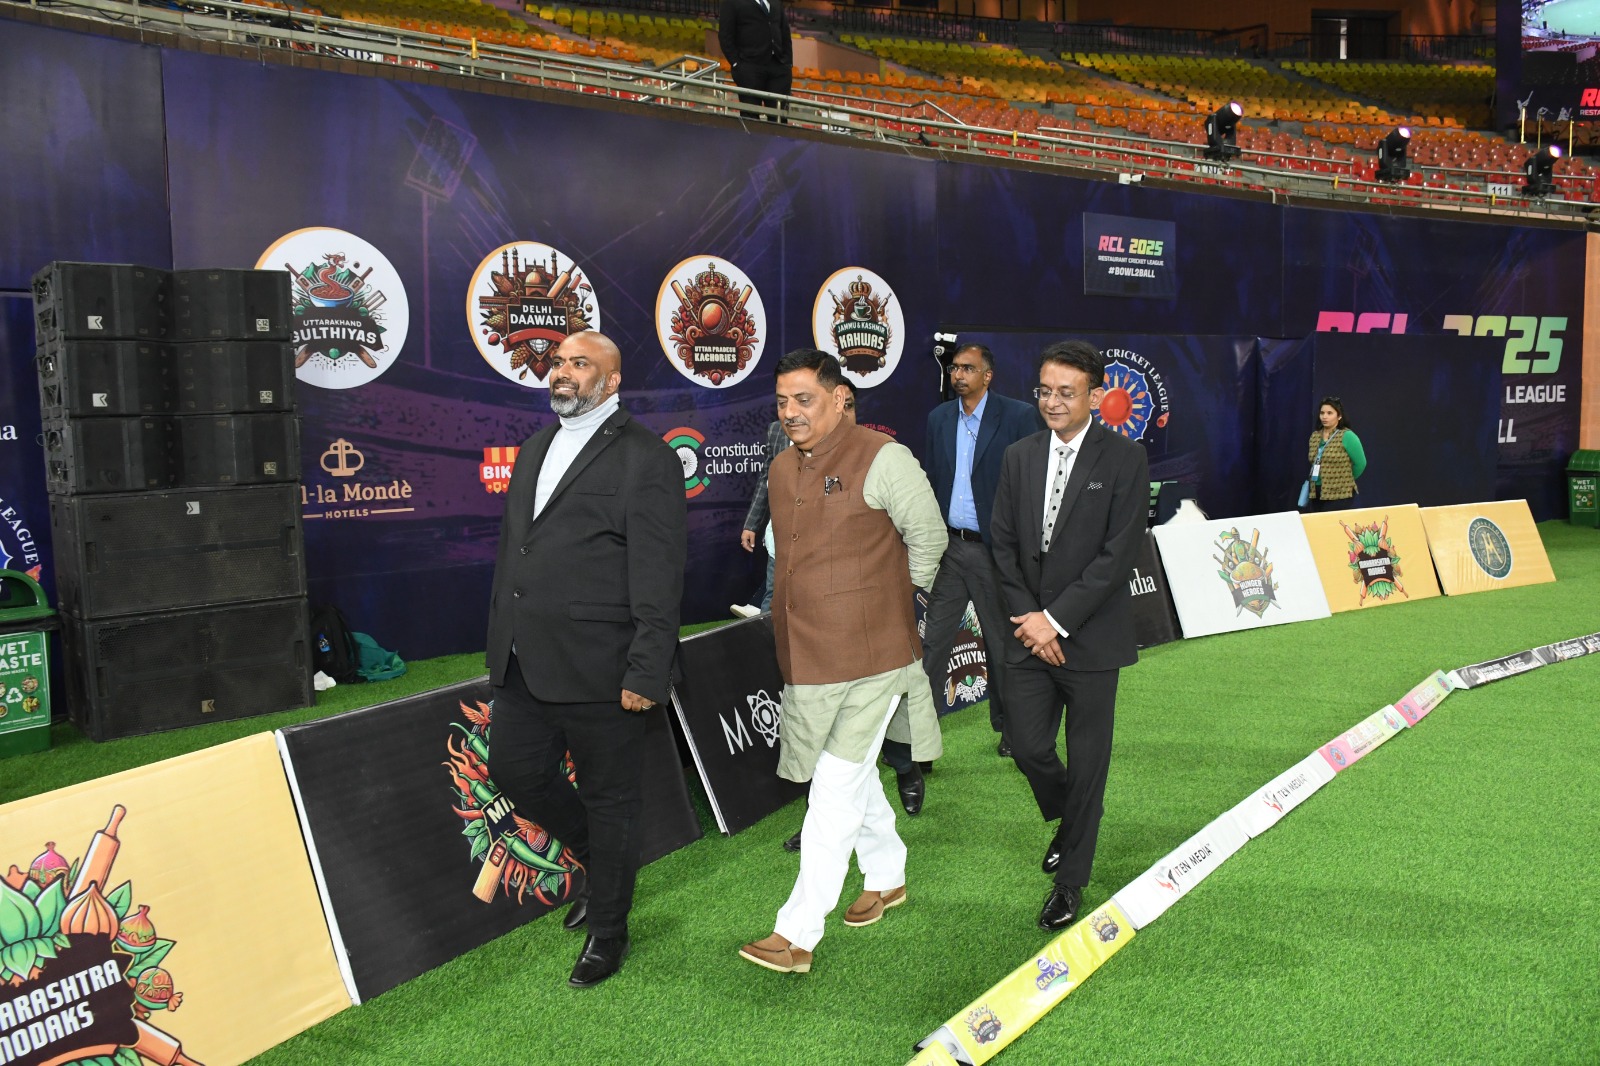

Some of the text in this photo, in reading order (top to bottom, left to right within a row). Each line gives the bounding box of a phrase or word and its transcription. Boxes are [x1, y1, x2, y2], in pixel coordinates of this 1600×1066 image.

[1492, 186, 1508, 196] 111
[1098, 235, 1164, 256] RCL 2025
[1097, 255, 1128, 263] RESTAURANT
[1128, 257, 1147, 265] CRICKET
[1108, 266, 1156, 278] #BOWL2BALL
[522, 304, 552, 314] DELHI
[303, 319, 362, 328] UTTARAKHAND
[509, 313, 566, 326] DAAWATS
[838, 322, 857, 333] JAMMU
[861, 322, 886, 334] KASHMIR
[838, 332, 885, 350] KAHWAS
[694, 345, 711, 353] UTTAR
[694, 353, 737, 362] KACHORIES
[1106, 348, 1169, 412] CRICKET LEAGUE
[1505, 384, 1567, 404] LEAGUE
[705, 457, 764, 475] club of in
[343, 479, 413, 502] Mondè
[325, 508, 369, 519] HOTELS
[0, 498, 40, 565] EAGUE
